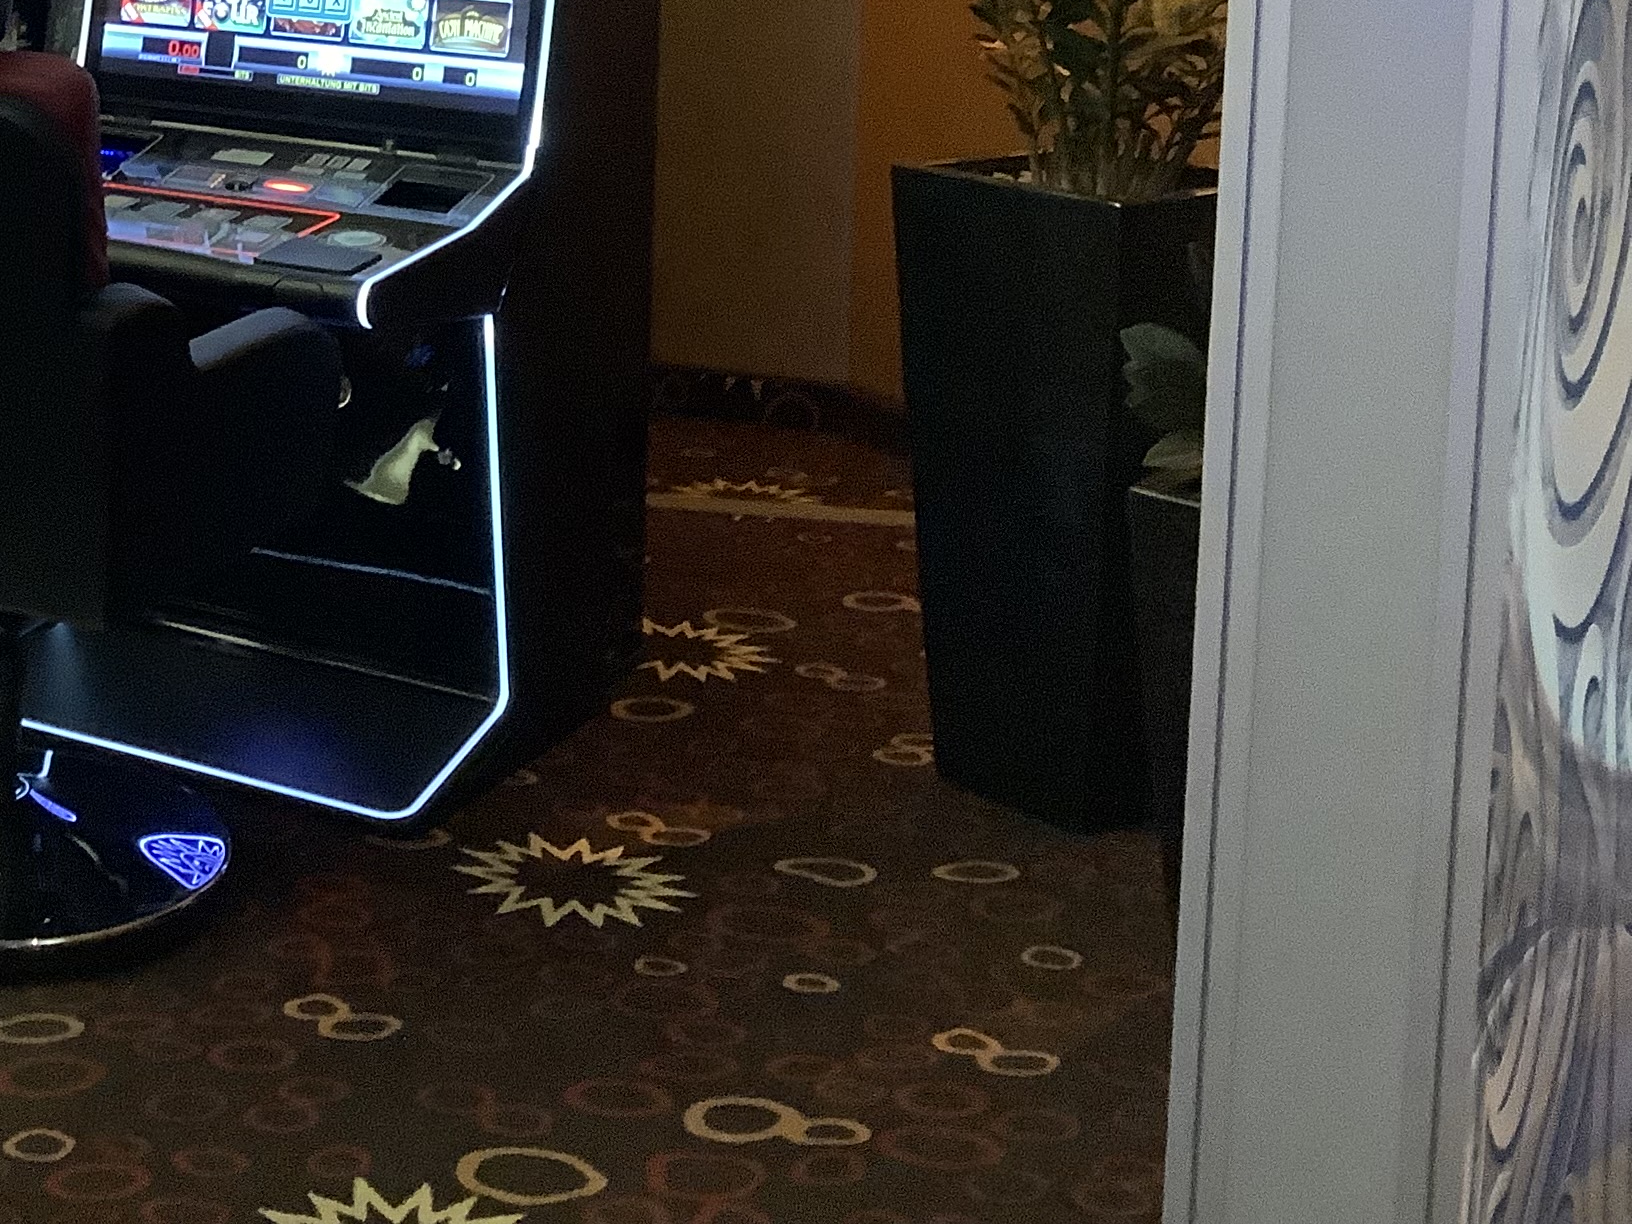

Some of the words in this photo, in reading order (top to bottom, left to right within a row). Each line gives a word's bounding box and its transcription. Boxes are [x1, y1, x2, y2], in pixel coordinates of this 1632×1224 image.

[168, 40, 200, 59] 0.00
[297, 56, 306, 69] 0
[413, 67, 422, 81] 0
[465, 72, 475, 86] 0
[279, 76, 342, 90] UNTERHALTUNG
[343, 81, 358, 91] MIT
[359, 83, 377, 94] BITS
